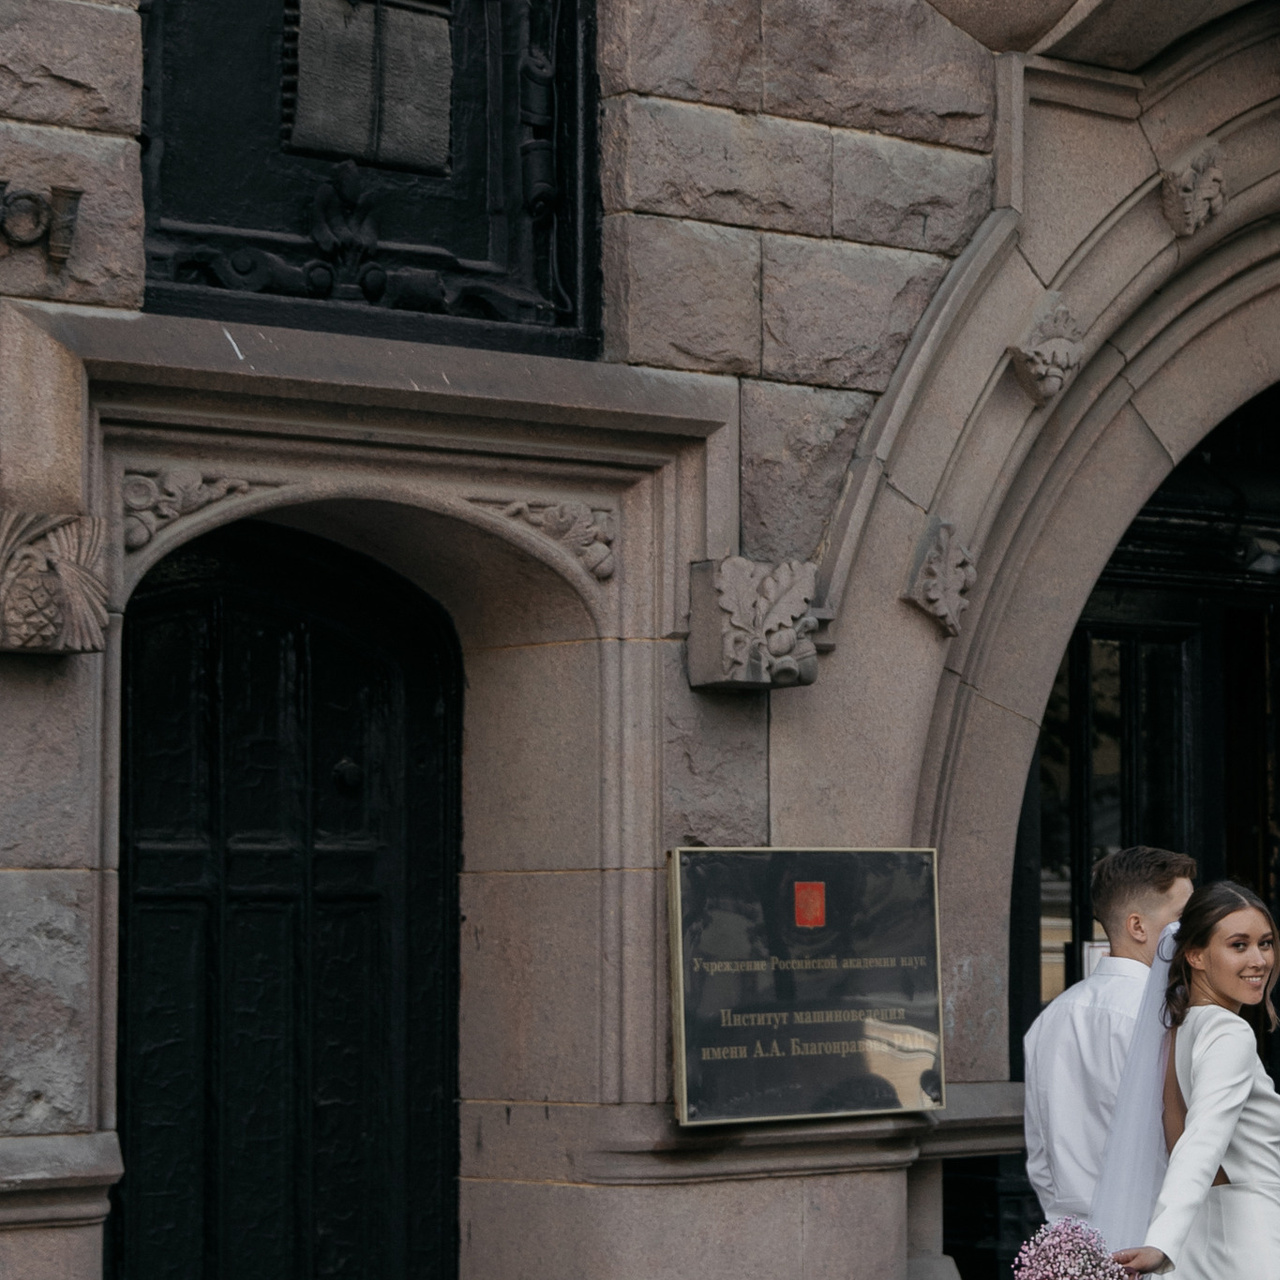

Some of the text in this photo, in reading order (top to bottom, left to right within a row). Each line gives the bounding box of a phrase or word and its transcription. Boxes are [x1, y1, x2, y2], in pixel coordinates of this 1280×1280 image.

[693, 955, 927, 975] Учреждение Российской академии наук
[721, 1008, 905, 1029] Институт машиноведения
[702, 1046, 747, 1060] имени
[754, 1039, 785, 1057] А.А.
[893, 1033, 924, 1048] РАН
